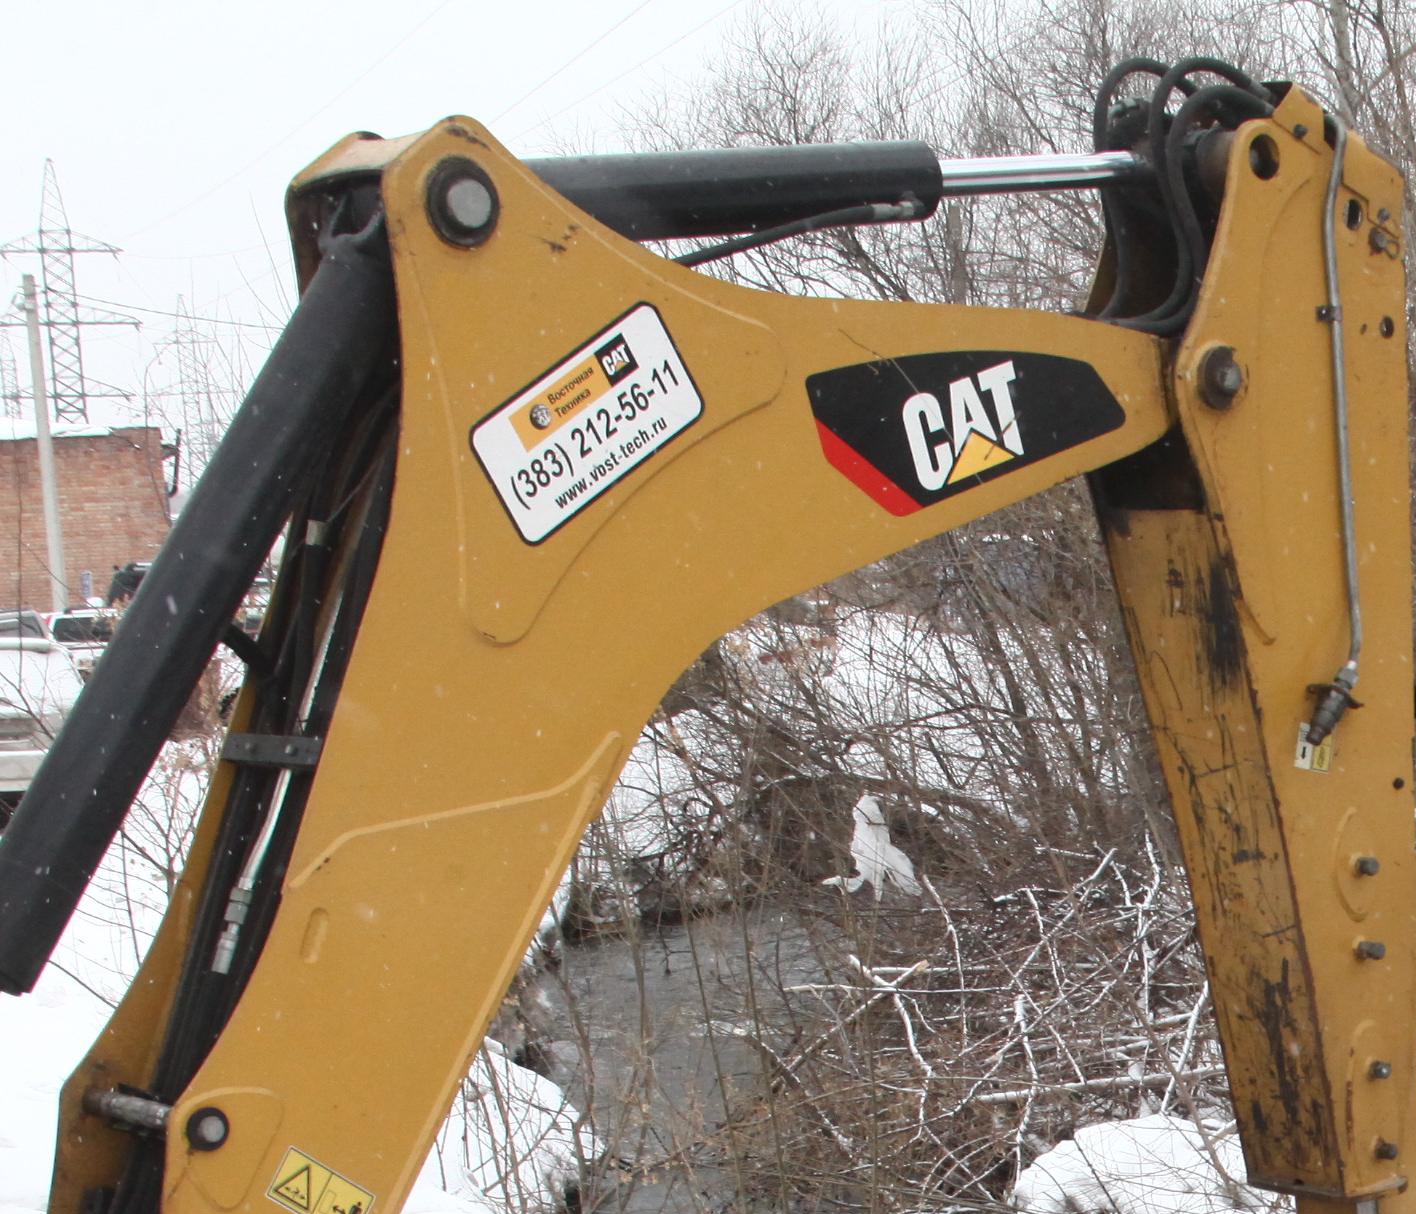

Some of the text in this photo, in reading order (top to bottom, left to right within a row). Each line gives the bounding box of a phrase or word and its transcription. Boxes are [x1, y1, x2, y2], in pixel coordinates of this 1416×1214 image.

[547, 367, 595, 404] Восточная
[602, 345, 631, 376] CAT
[511, 360, 679, 510] (383) 212-56-11
[554, 389, 592, 418] Техника
[903, 360, 1025, 491] CAT
[555, 418, 668, 509] www.vost-tech.ru
